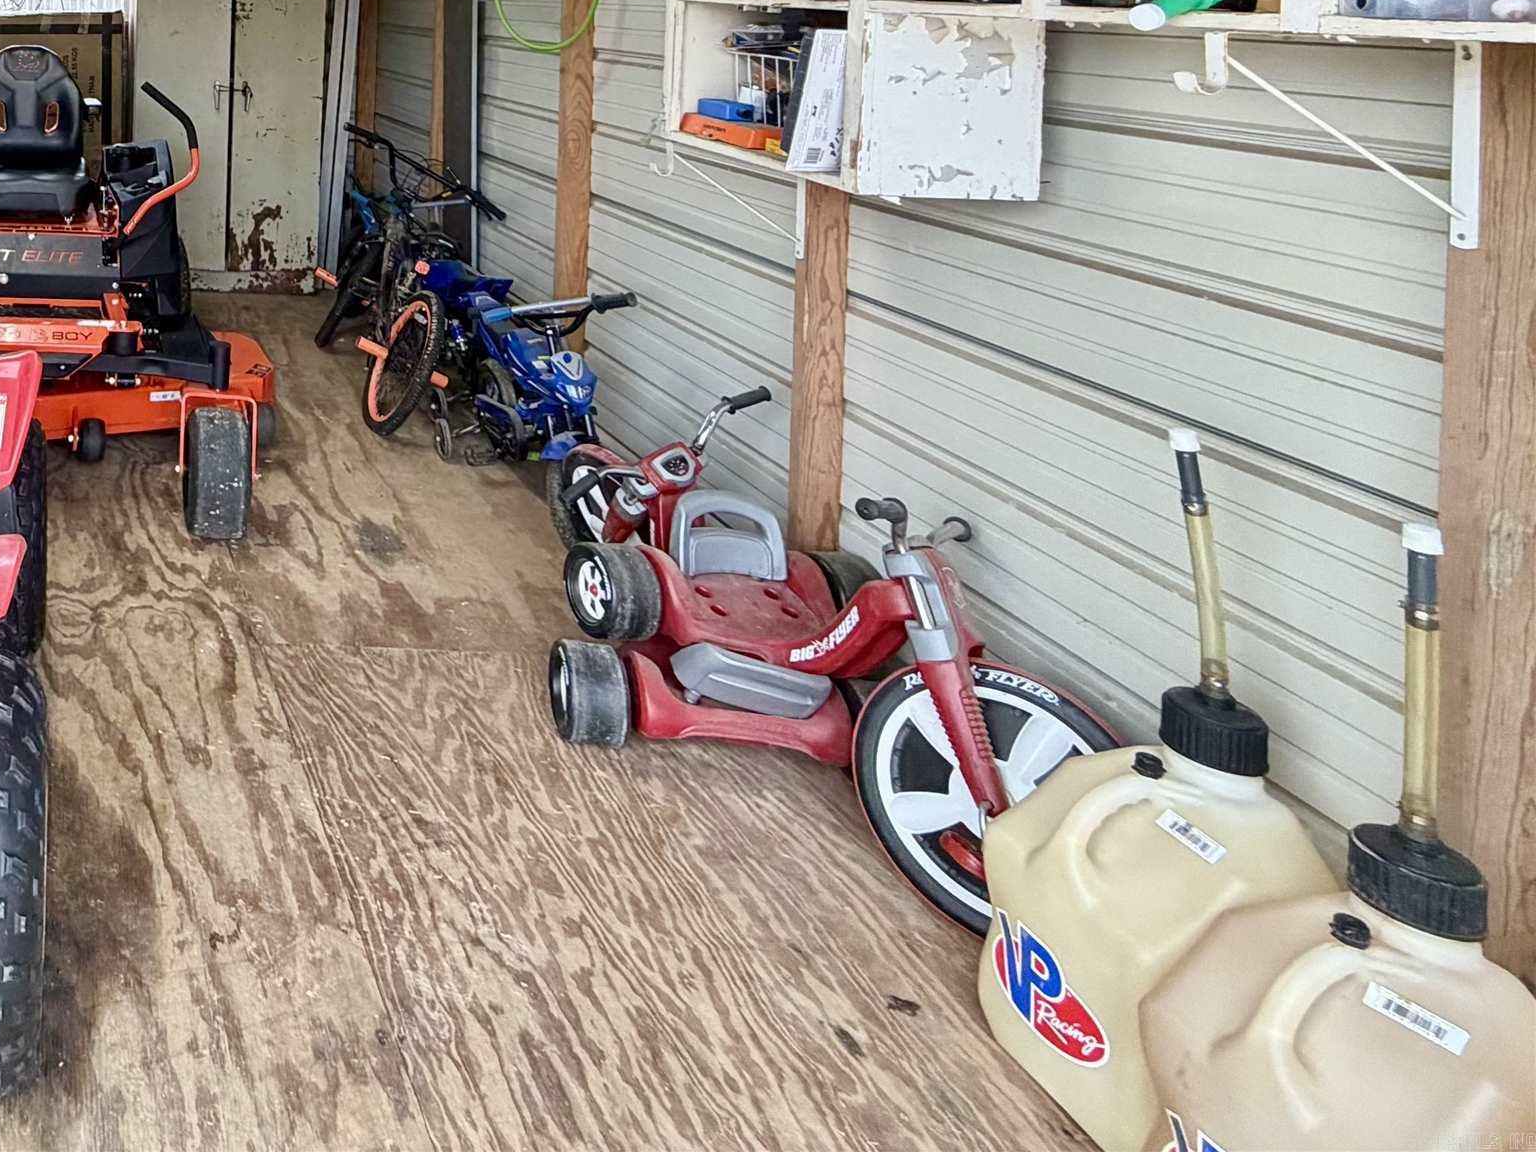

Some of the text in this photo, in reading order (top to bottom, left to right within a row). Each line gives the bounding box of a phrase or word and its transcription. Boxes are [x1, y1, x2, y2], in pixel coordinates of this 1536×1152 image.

[21, 250, 83, 263] ELITE
[52, 331, 93, 341] BOY
[789, 605, 861, 663] BIG FLYER
[986, 669, 1061, 707] FLYER
[996, 908, 1064, 1026] VP
[1035, 999, 1107, 1057] Racing
